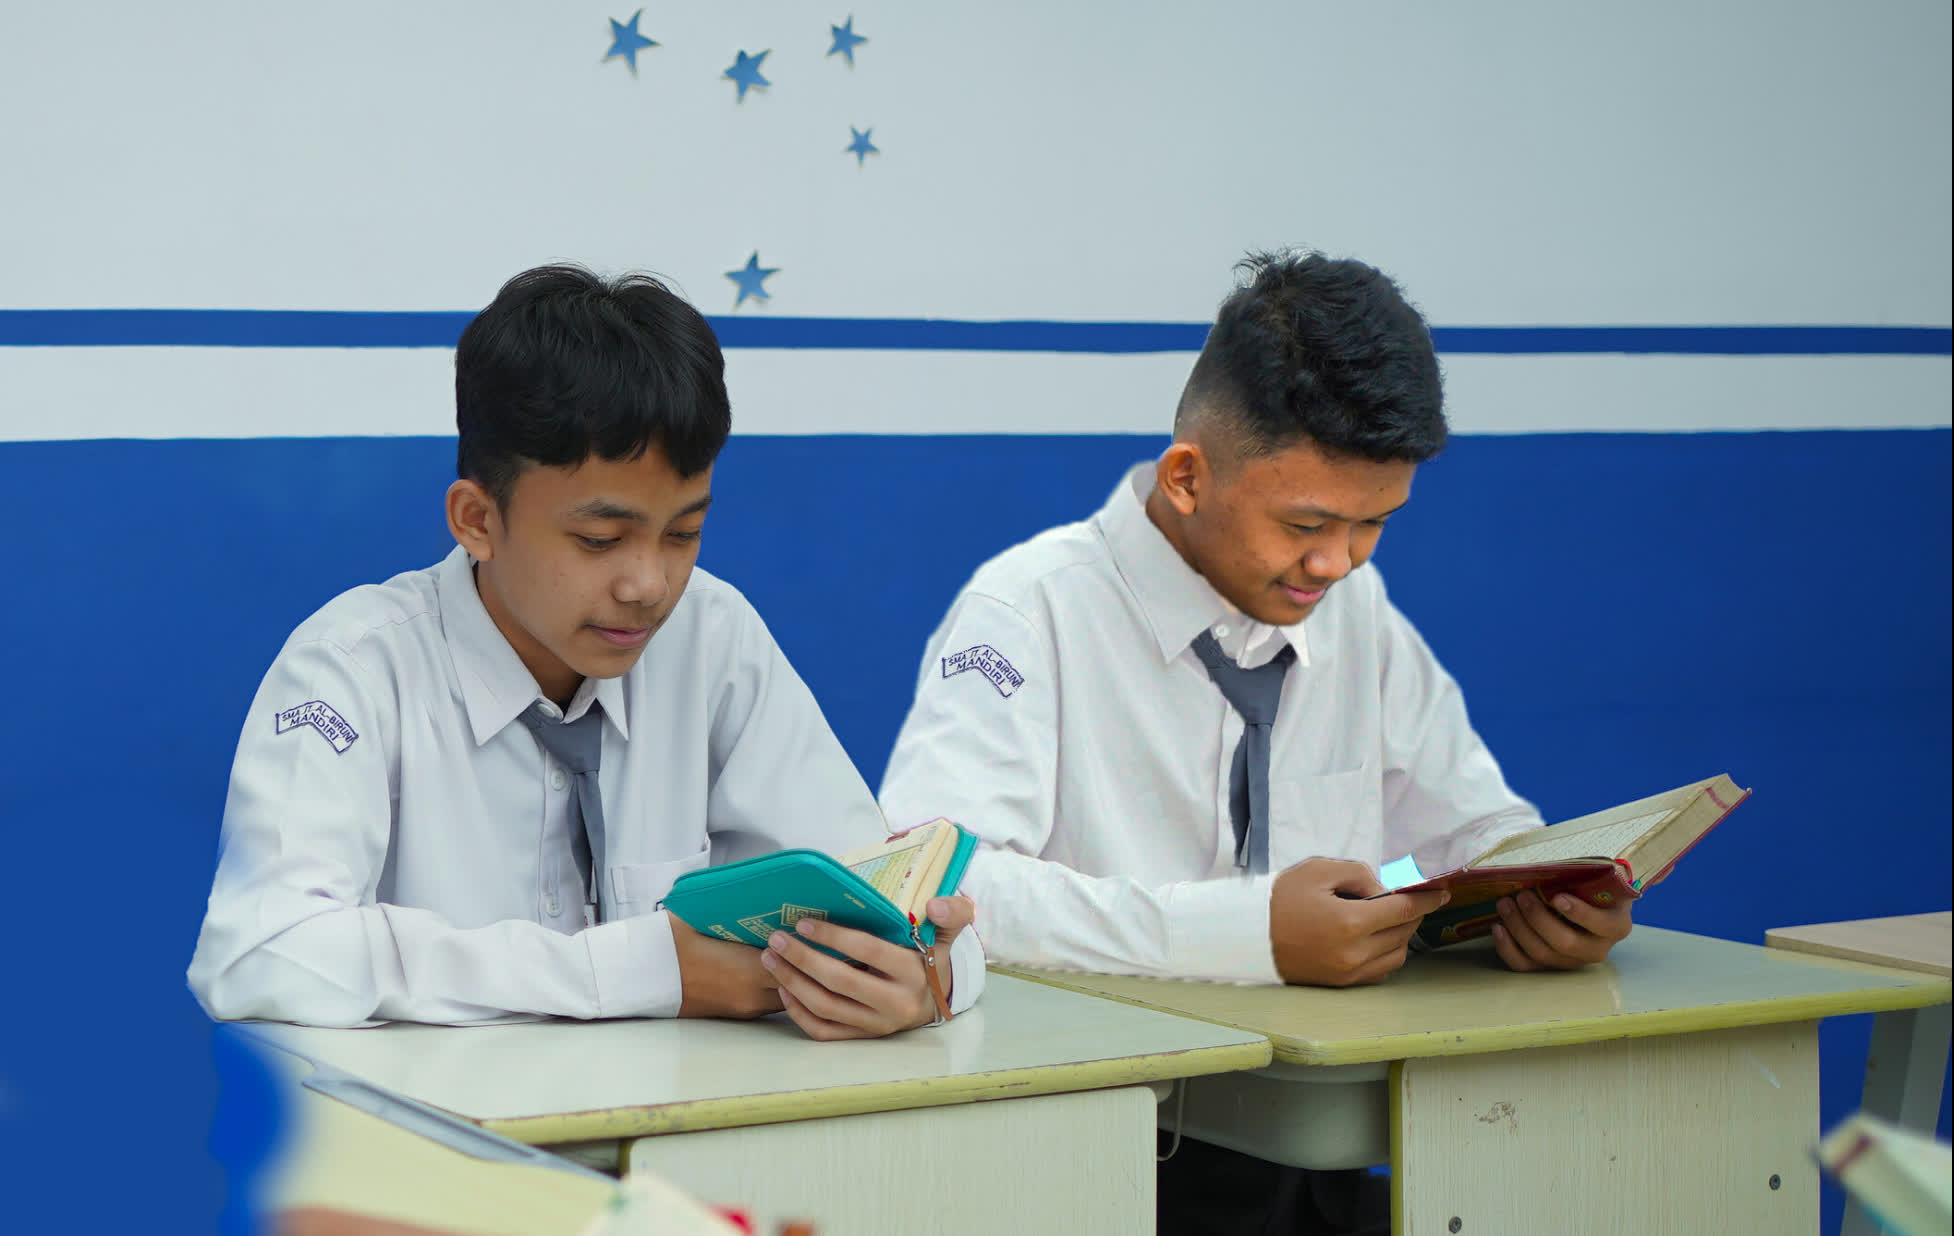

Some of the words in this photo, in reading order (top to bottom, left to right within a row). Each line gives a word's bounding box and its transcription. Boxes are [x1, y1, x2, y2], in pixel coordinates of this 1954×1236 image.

[948, 654, 967, 666] SMA
[957, 657, 1006, 685] MANDIRI
[282, 709, 300, 722] SMA
[290, 712, 340, 741] MANDIRI
